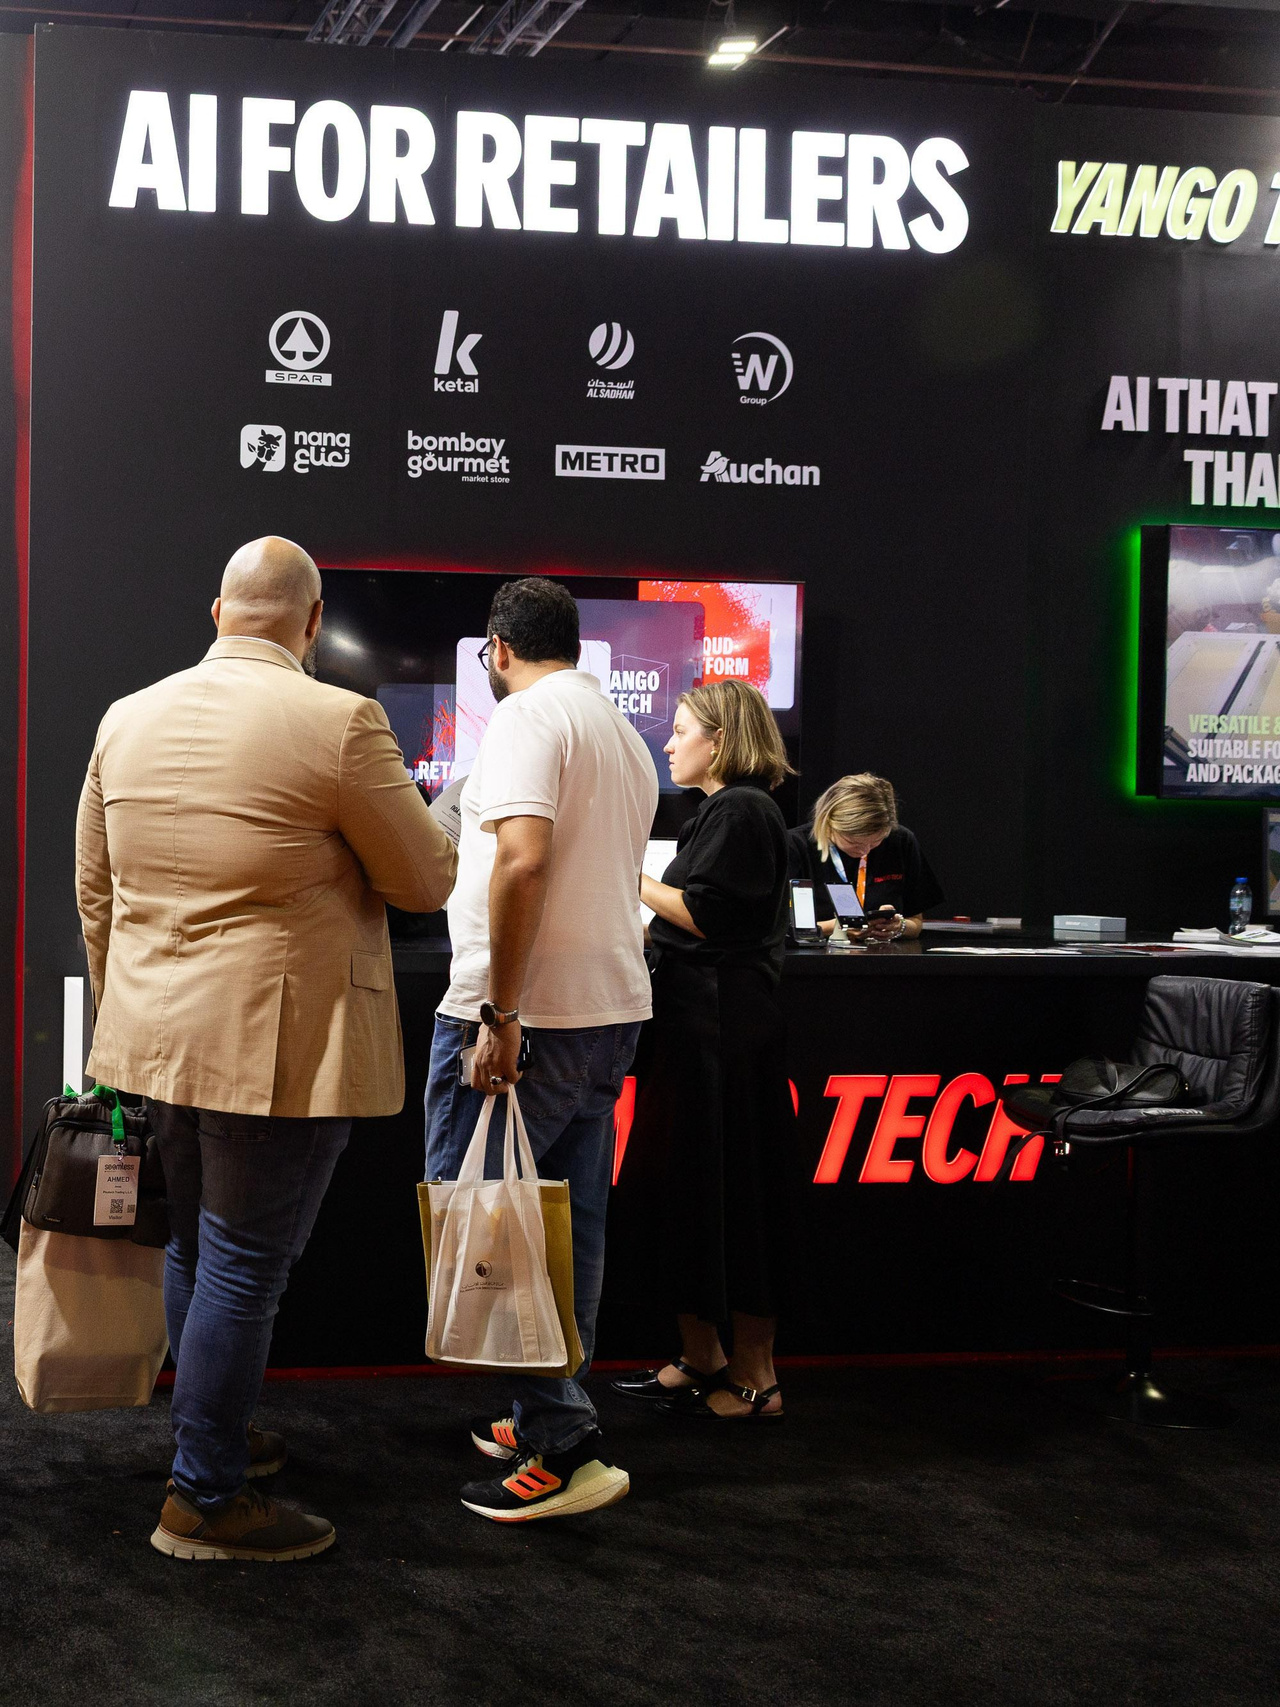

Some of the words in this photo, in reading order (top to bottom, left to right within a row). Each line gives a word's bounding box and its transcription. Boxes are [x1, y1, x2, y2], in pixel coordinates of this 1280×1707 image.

[108, 90, 217, 212] AI
[240, 97, 436, 226] FOR
[455, 110, 971, 254] RETAILERS
[1050, 160, 1259, 243] YANGO
[275, 372, 323, 384] SPAR
[434, 377, 479, 393] ketal
[586, 388, 599, 398] AL
[599, 389, 635, 399] SADHAN
[740, 395, 767, 406] Group
[1101, 375, 1150, 432] AI
[1158, 377, 1279, 437] THAT
[294, 431, 351, 447] nana
[407, 430, 505, 458] bombay
[407, 452, 510, 478] gourmet
[561, 451, 660, 474] METRO
[700, 451, 820, 486] Auchan
[461, 475, 489, 483] market
[490, 475, 510, 483] store
[1183, 449, 1280, 508] THA
[703, 657, 750, 677] FORM
[609, 670, 661, 692] ANGO
[1188, 714, 1271, 735] VERSATILE
[1187, 738, 1261, 759] SUITABLE
[1186, 763, 1221, 783] AND
